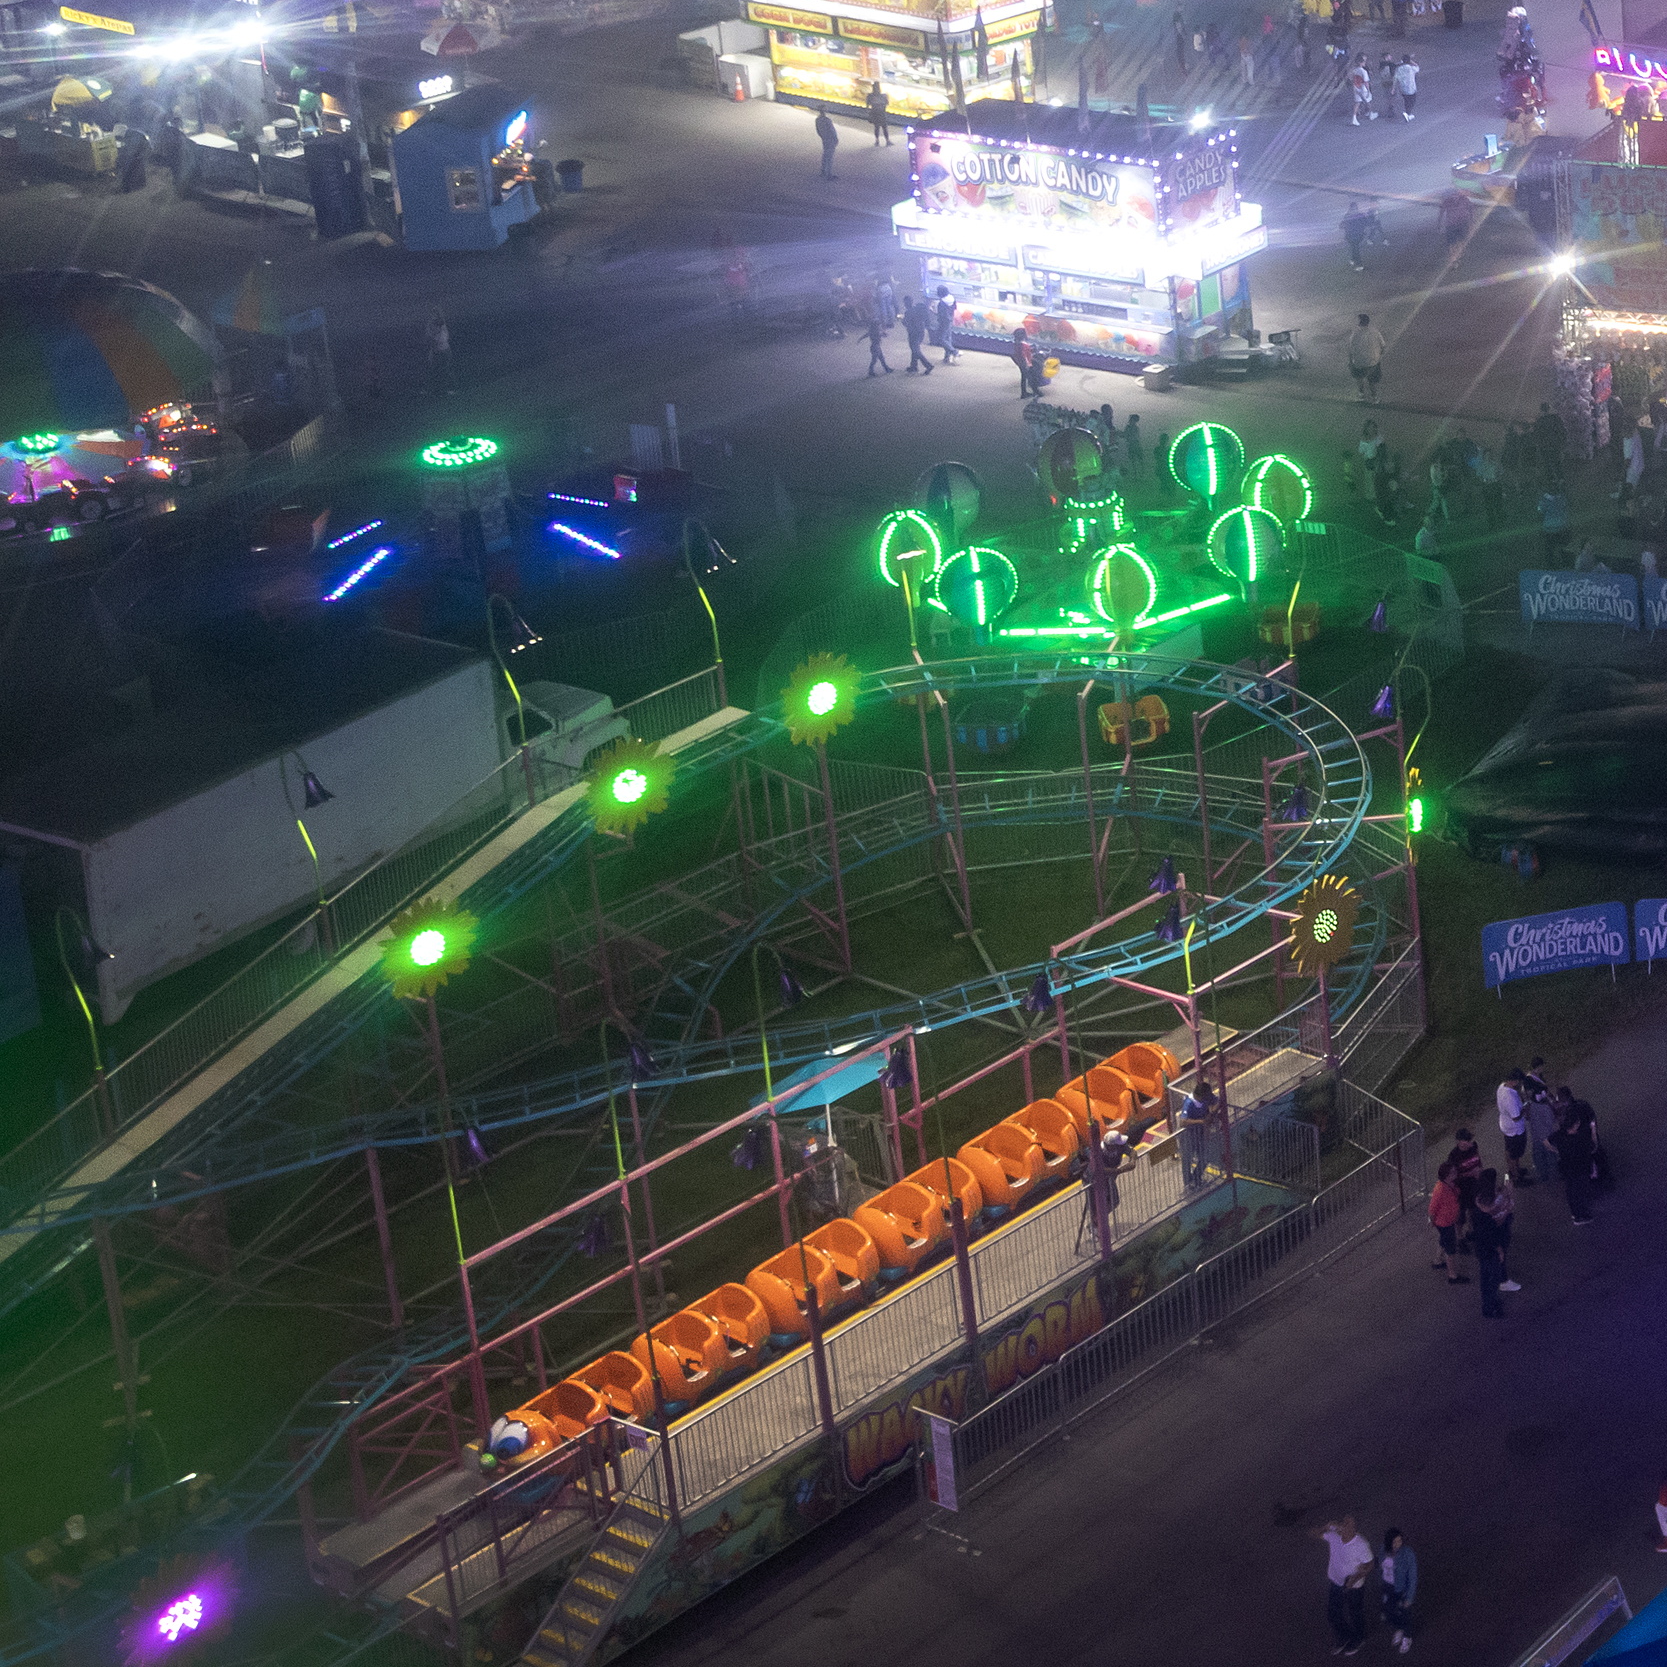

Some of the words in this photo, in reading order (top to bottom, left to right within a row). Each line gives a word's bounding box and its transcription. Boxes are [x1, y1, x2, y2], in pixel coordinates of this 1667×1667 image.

[951, 151, 1037, 186] COTTON
[1040, 154, 1120, 207] CANDY
[1175, 150, 1227, 182] CANDY
[1176, 166, 1228, 202] APPLES
[904, 230, 1012, 262] LEMONADE
[1538, 574, 1622, 599] Christmas
[1523, 592, 1636, 622] WONDERLAND
[1507, 917, 1607, 948] Christmas
[1489, 930, 1624, 981] WONDERLAND
[1520, 960, 1570, 976] TROPICAL
[1572, 955, 1599, 966] PARK
[848, 1367, 969, 1483] WACKY
[984, 1275, 1103, 1394] WORM
